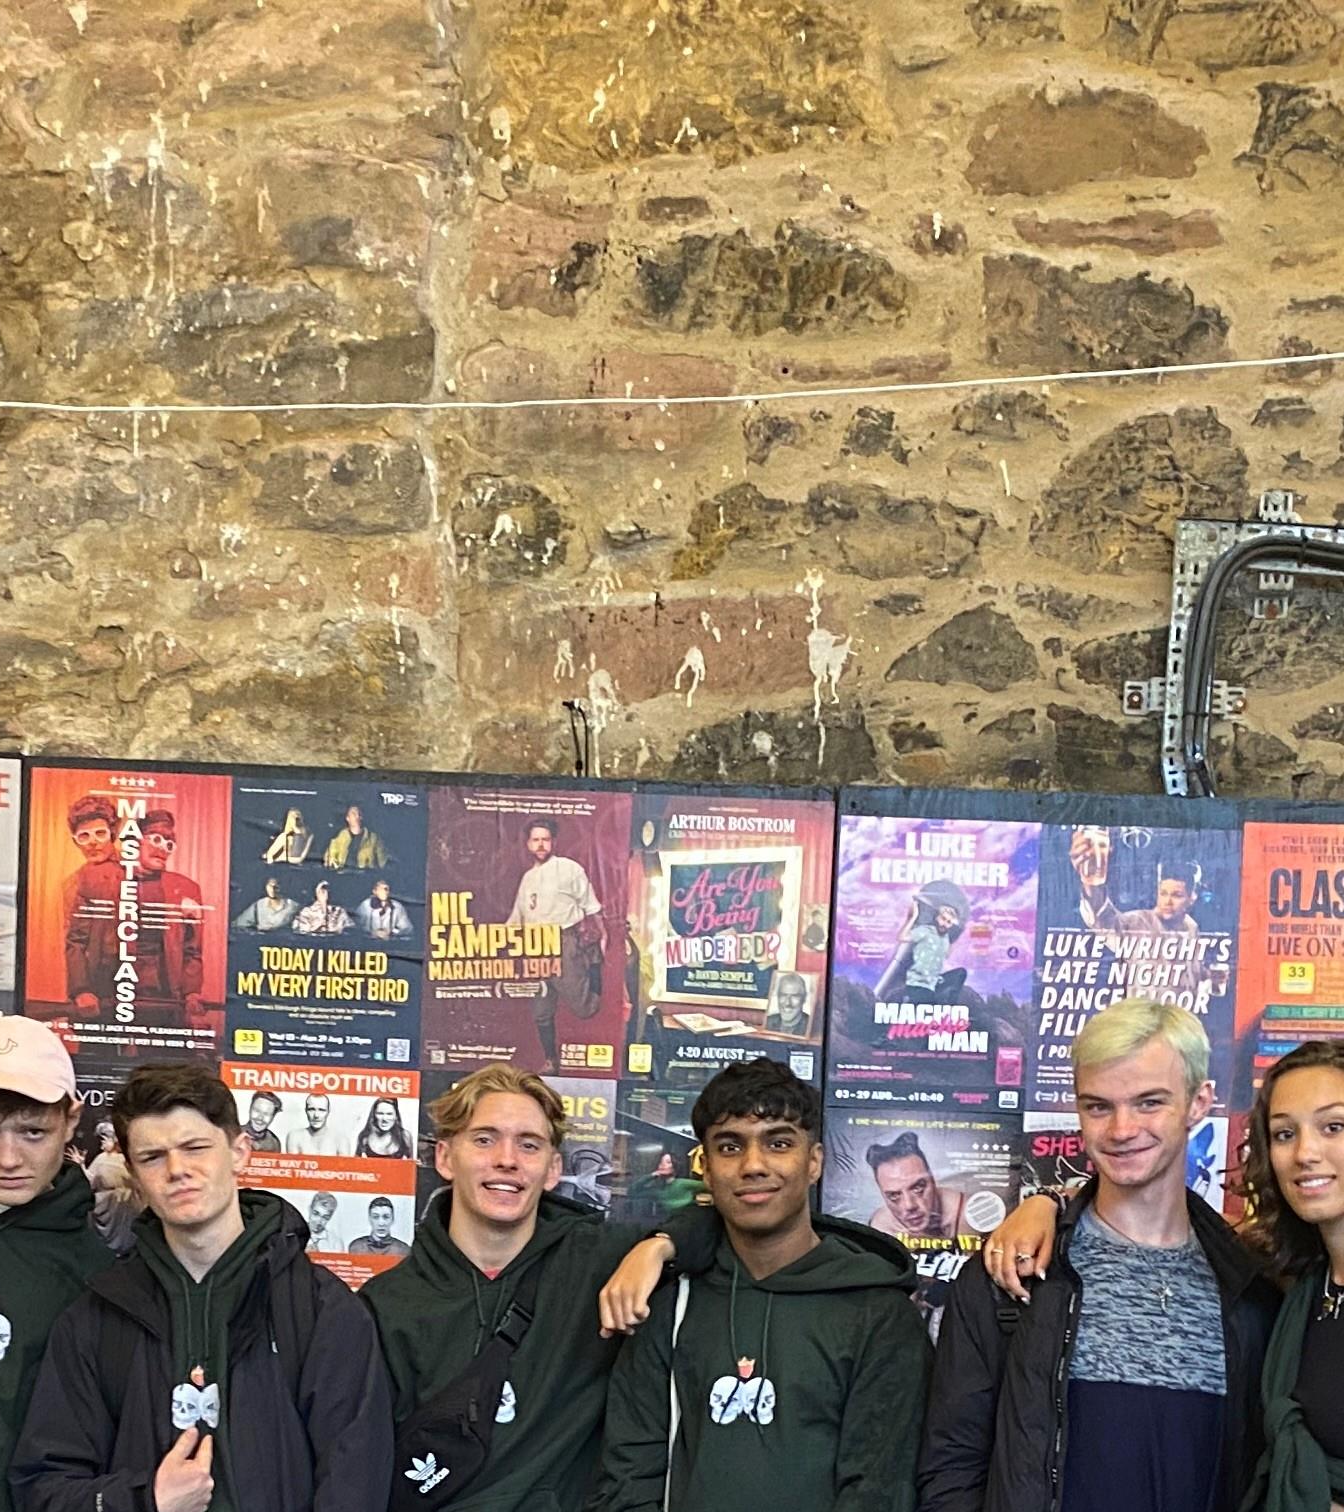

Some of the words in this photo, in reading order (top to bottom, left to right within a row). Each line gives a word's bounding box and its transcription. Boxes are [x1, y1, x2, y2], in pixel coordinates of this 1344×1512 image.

[669, 814, 727, 831] ARTHUR
[728, 816, 796, 833] BOSTROM
[905, 831, 977, 859] LUKE
[870, 857, 1010, 888] KEMPNER
[672, 868, 727, 909] Are
[725, 865, 779, 910] You
[112, 799, 147, 1024] MASTERCLASS
[431, 891, 474, 925] NIC
[684, 900, 762, 937] Being
[429, 923, 562, 959] SAMPSON
[1319, 924, 1343, 936] THAN
[666, 932, 782, 968] MURDERED?
[1042, 933, 1106, 959] LUKE
[1114, 935, 1233, 962] WRIGHT'S
[1267, 936, 1302, 956] LIVE
[1306, 937, 1337, 957] ON
[259, 946, 315, 972] TODAY
[316, 949, 324, 973] I
[327, 950, 388, 975] KILLED
[522, 958, 562, 979] 1904
[1287, 966, 1306, 978] 33
[1041, 960, 1100, 984] LATE
[1107, 962, 1186, 987] NIGHT
[237, 971, 266, 996] MY
[268, 973, 313, 998] VERY
[315, 974, 366, 1000] FIRST
[367, 978, 409, 1003] BIRD
[874, 1002, 971, 1025] MACHO
[1135, 990, 1210, 1014] OOR
[242, 1032, 256, 1042] 33
[927, 1030, 990, 1053] MAN
[593, 1047, 608, 1056] 33
[676, 1046, 701, 1058] 4-20
[701, 1048, 745, 1060] AUGUST
[231, 1068, 403, 1094] TRAINSPOTTING
[76, 1089, 116, 1107] YDE
[563, 1095, 609, 1119] ars
[240, 1167, 293, 1178] PERIENCE
[251, 1157, 277, 1168] BEST
[279, 1158, 302, 1169] WAY
[303, 1160, 319, 1170] TO
[956, 1234, 986, 1251] Wi
[418, 1467, 451, 1494] adidas
